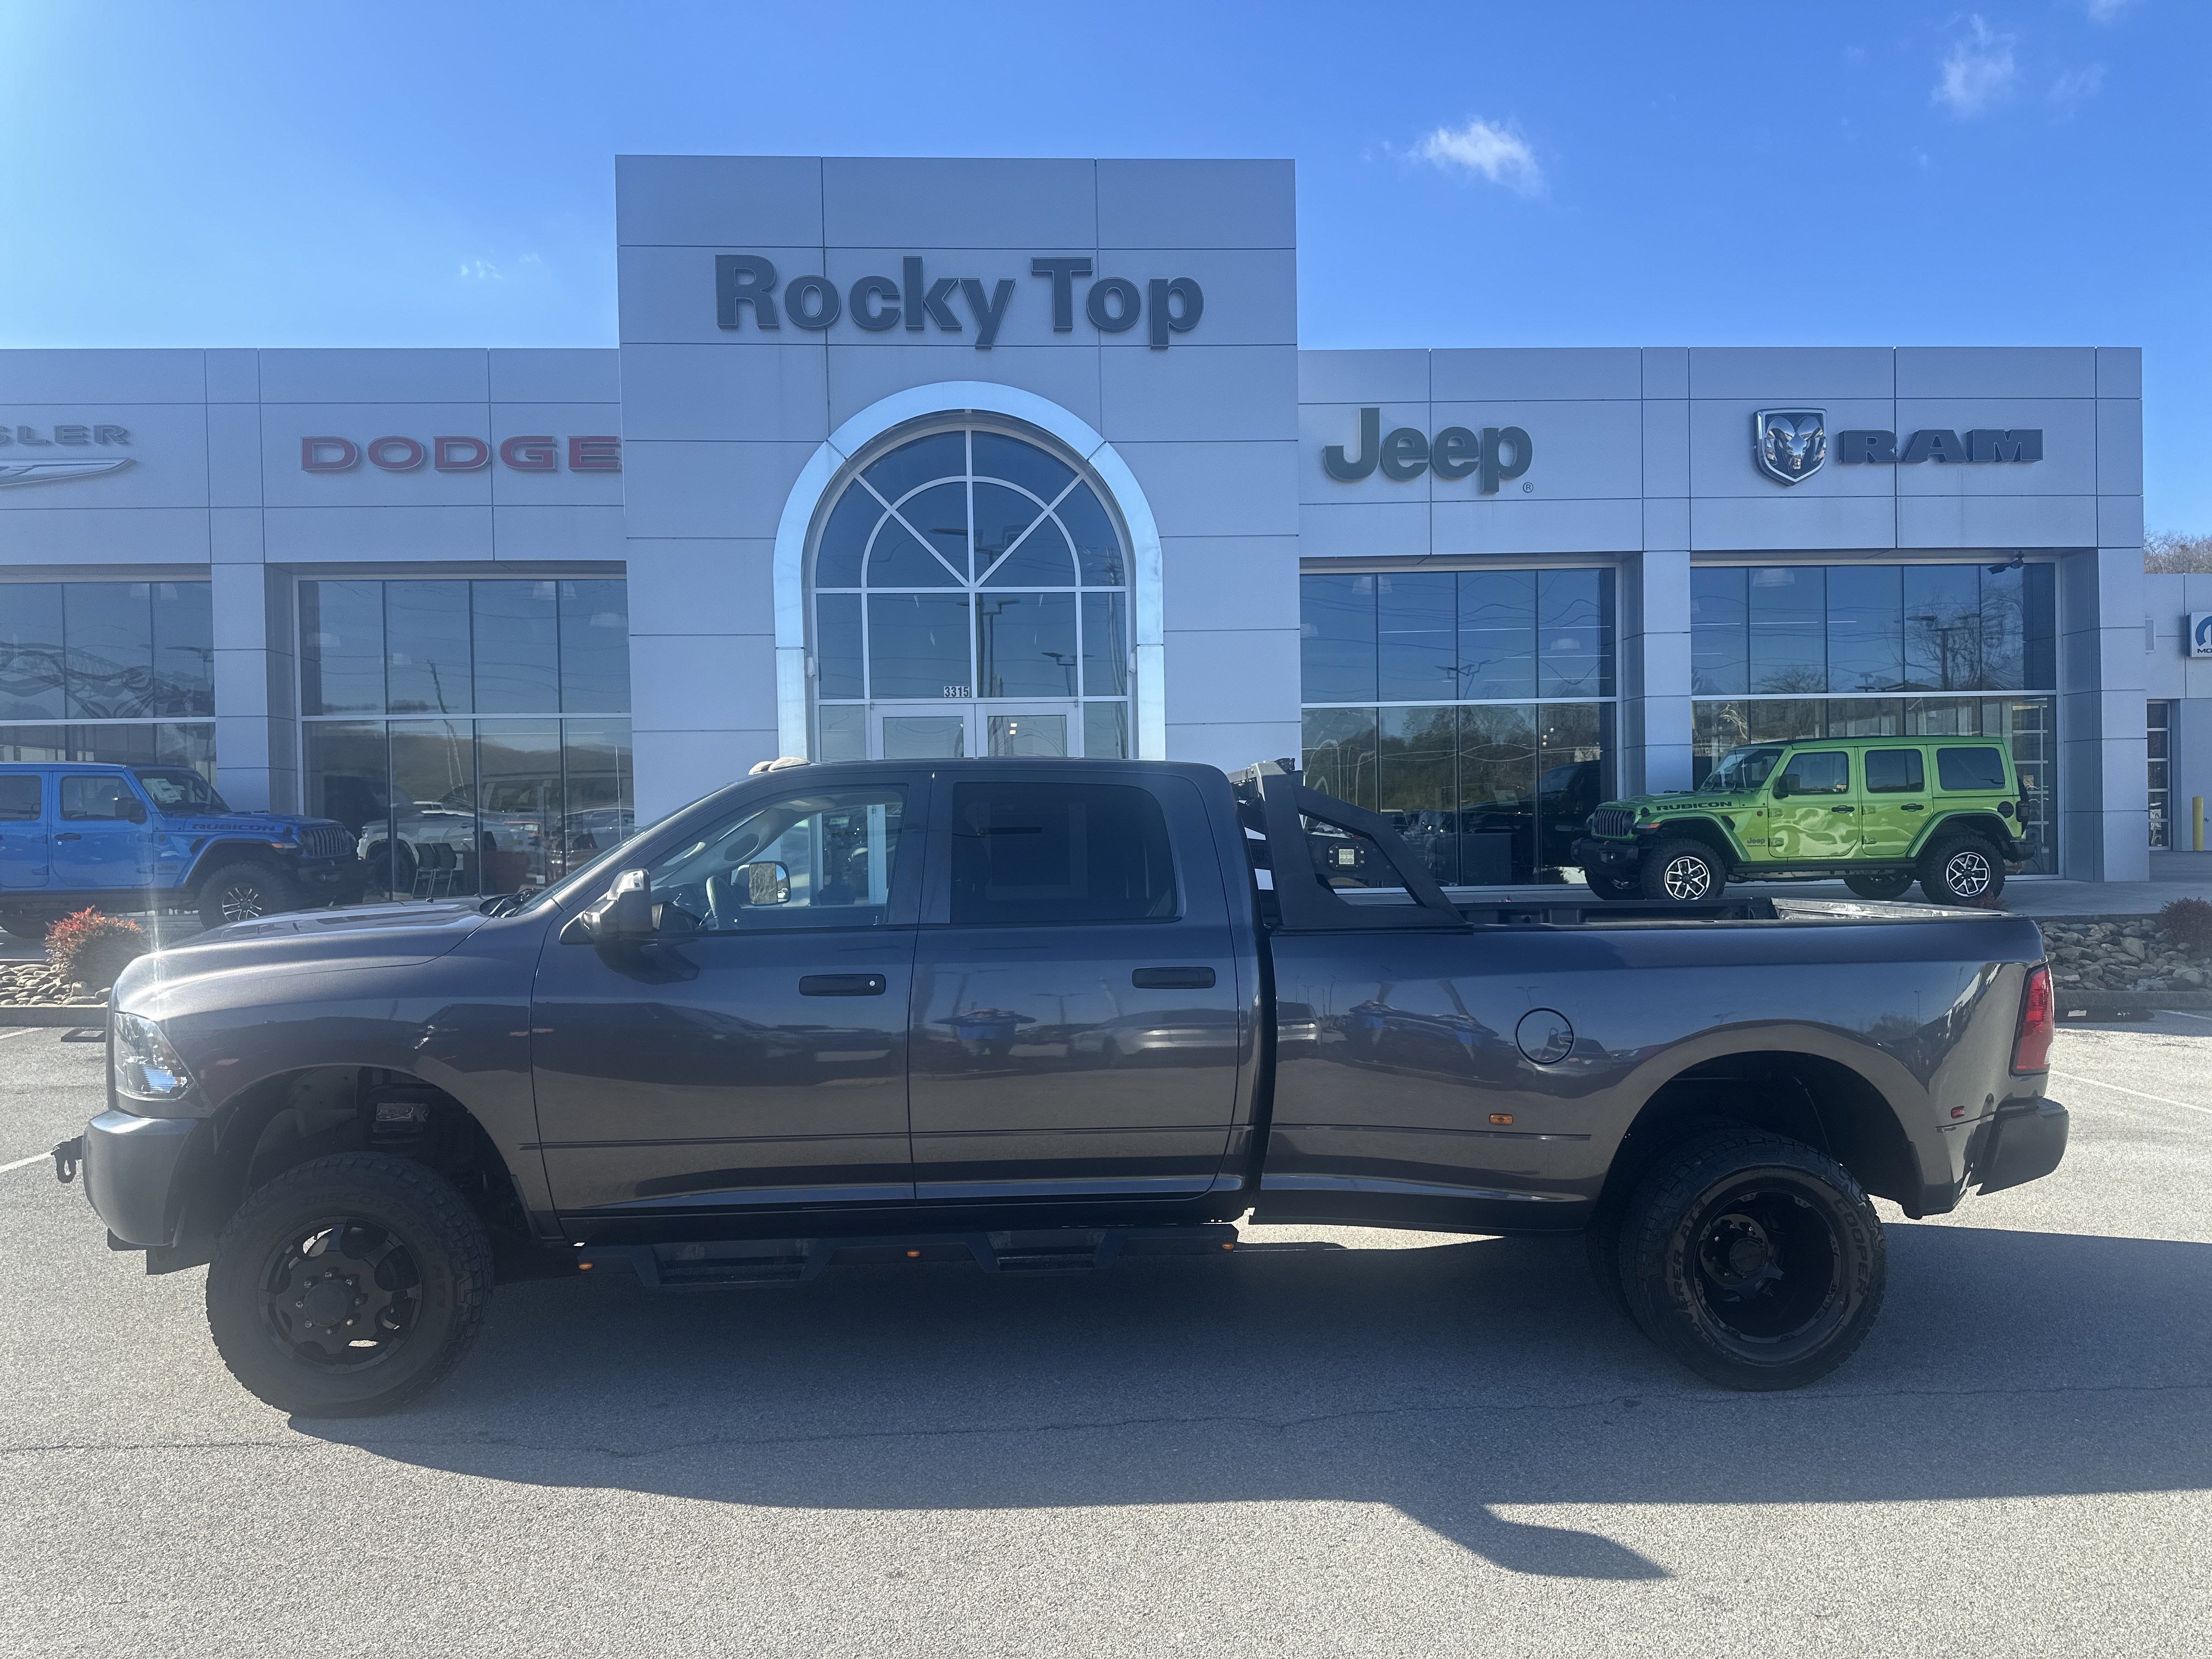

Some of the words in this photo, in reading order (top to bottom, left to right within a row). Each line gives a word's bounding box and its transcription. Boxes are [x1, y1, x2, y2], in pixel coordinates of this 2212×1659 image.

[714, 254, 1015, 350] Rocky
[1031, 257, 1204, 349] Top
[0, 425, 129, 444] LER
[1323, 407, 1533, 494] Jeep
[1839, 428, 2043, 464] RAM
[300, 435, 622, 472] DODGE
[945, 686, 969, 697] 3315
[1656, 801, 1732, 811] RUBICON
[1833, 1199, 1868, 1296] COOPER
